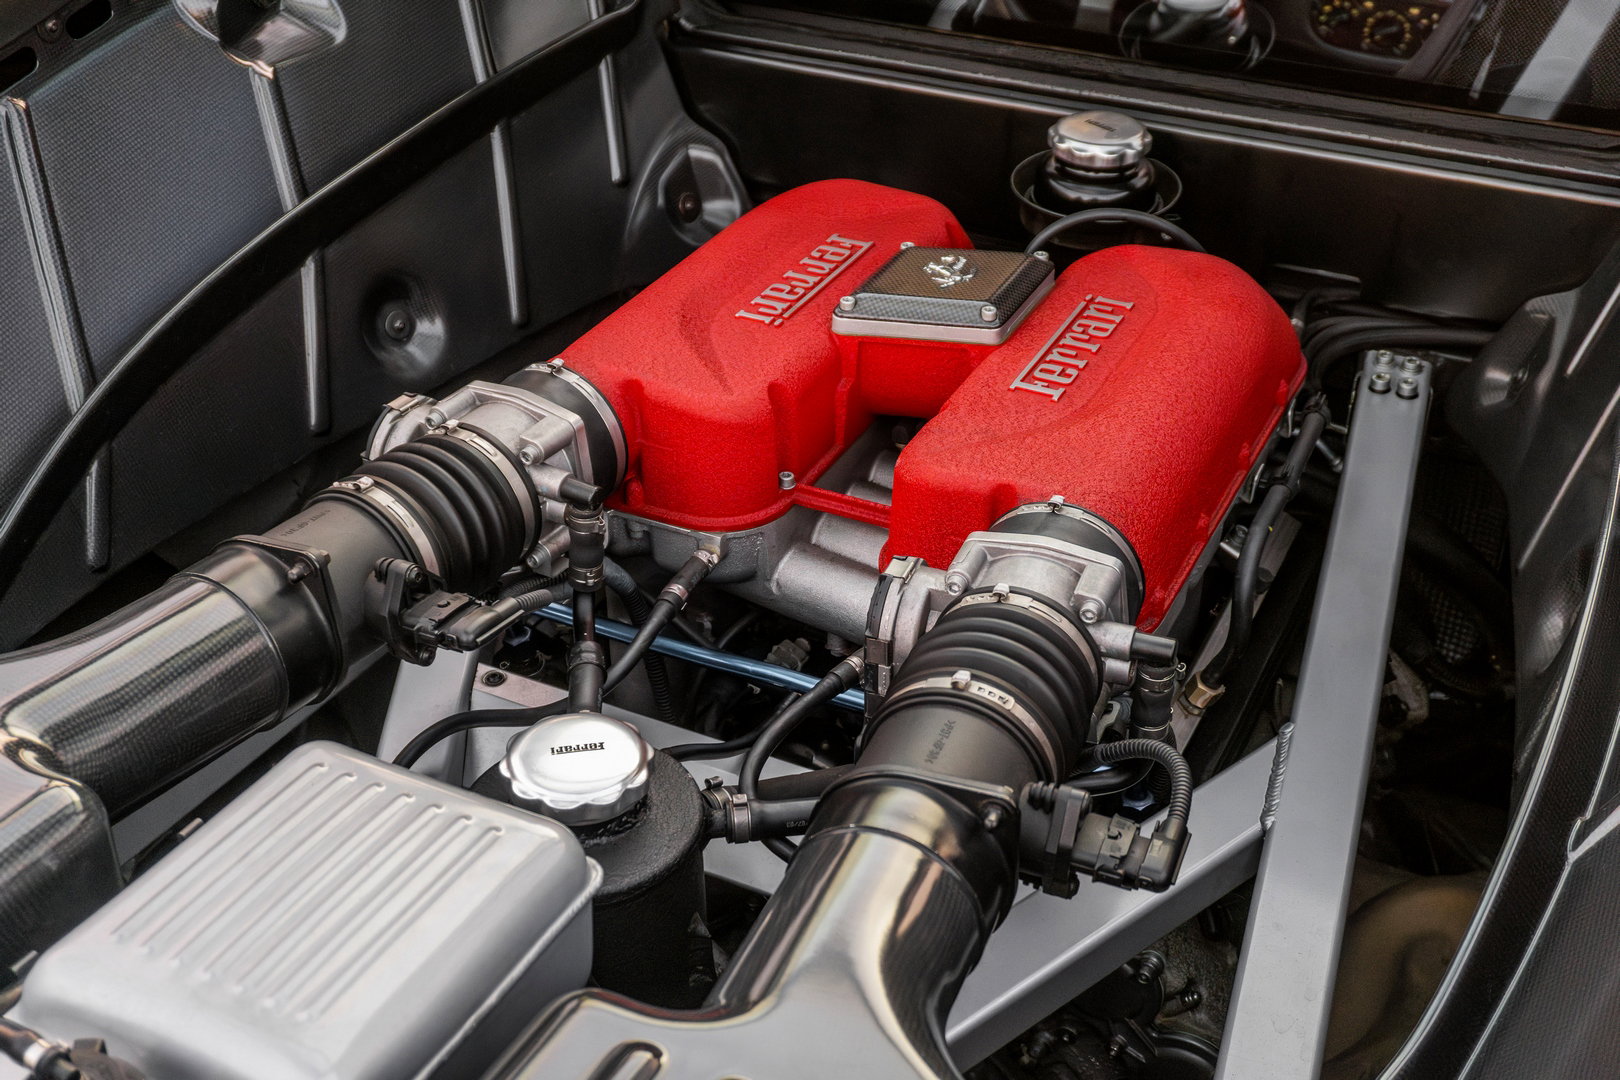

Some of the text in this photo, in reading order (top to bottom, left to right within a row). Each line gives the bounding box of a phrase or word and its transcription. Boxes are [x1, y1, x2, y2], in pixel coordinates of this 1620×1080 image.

[735, 233, 874, 326] Ferrari
[1009, 293, 1135, 401] Ferrari
[550, 742, 605, 756] Ferrari
